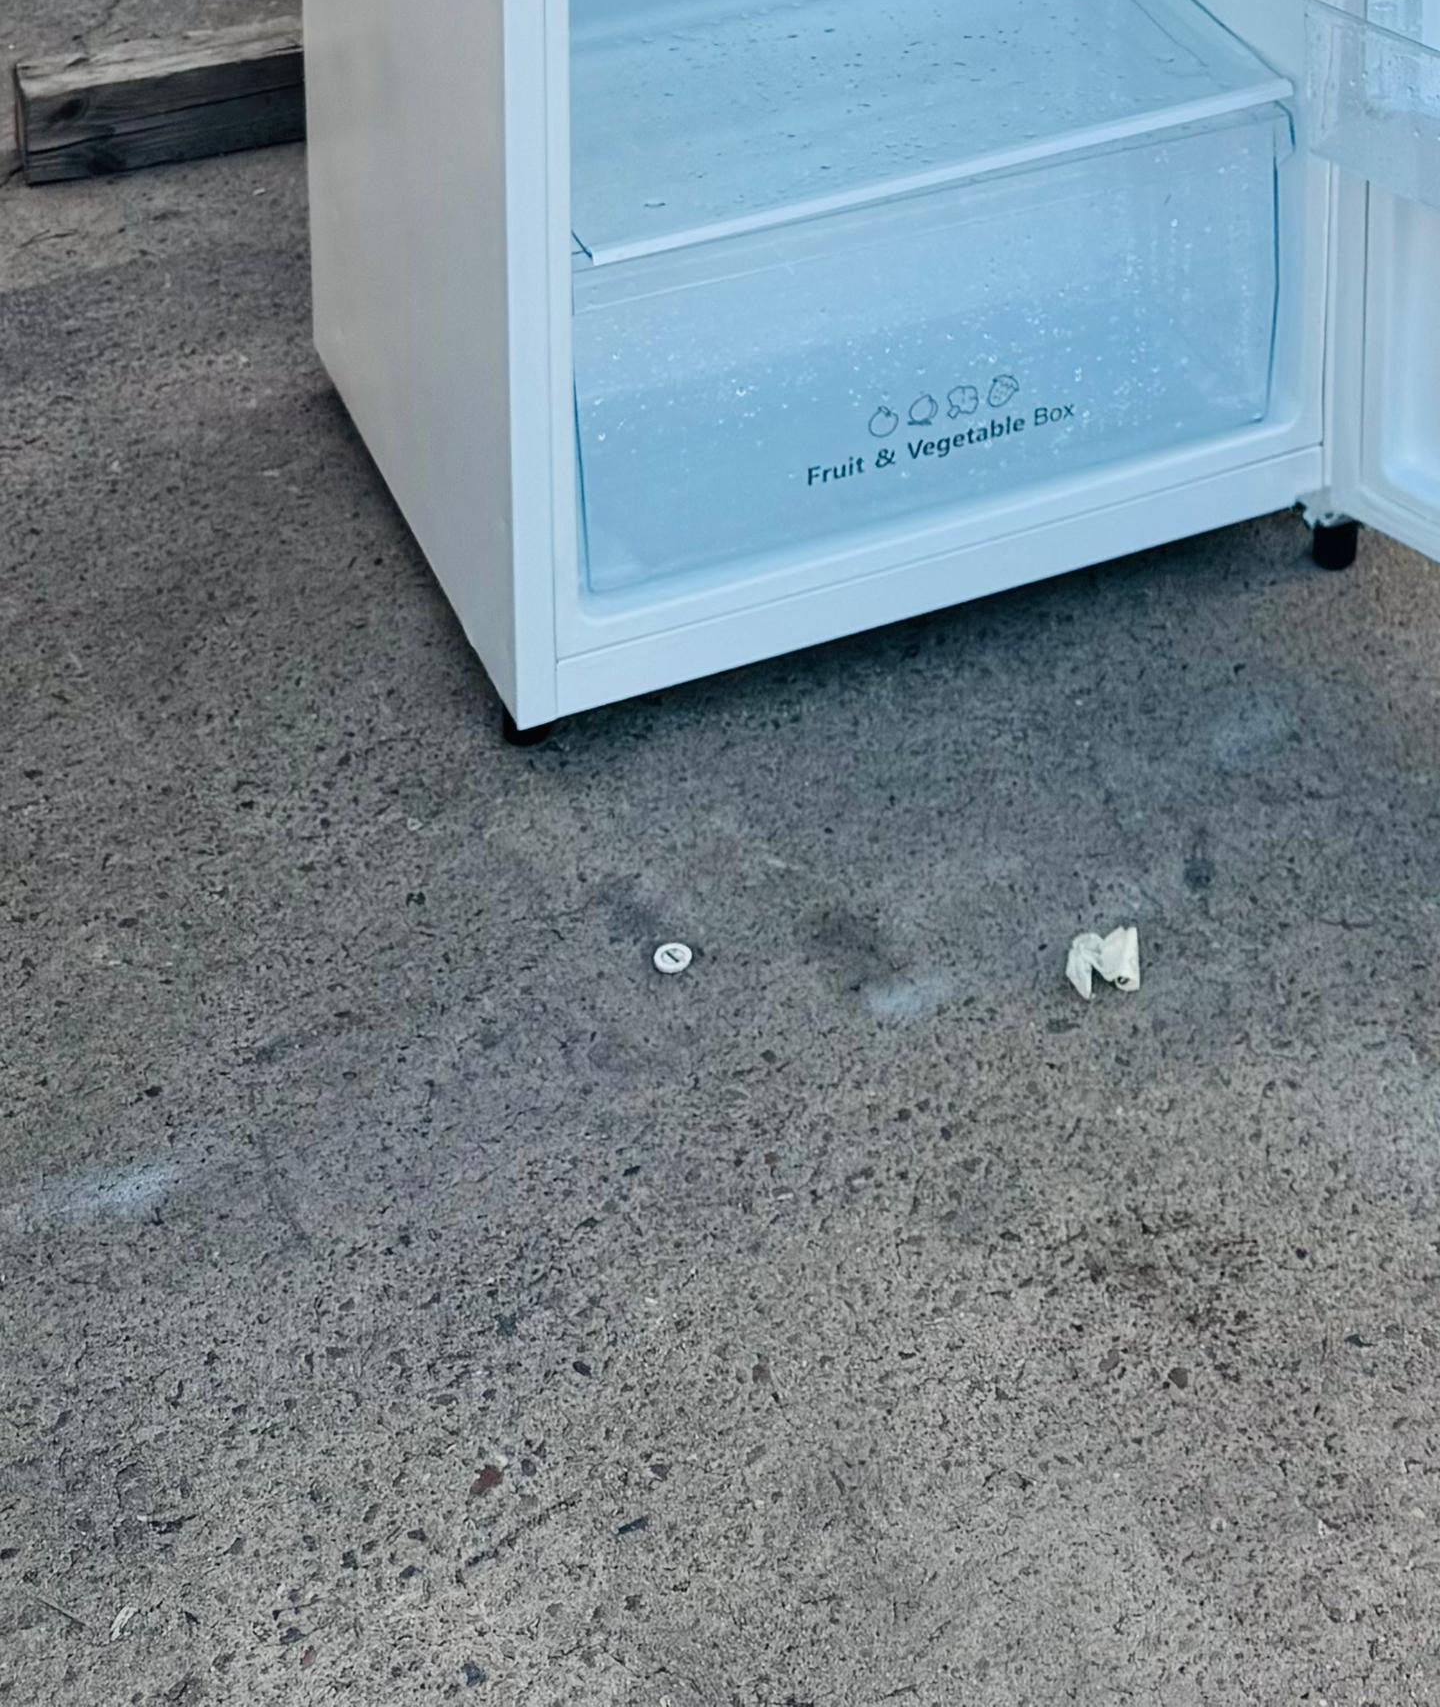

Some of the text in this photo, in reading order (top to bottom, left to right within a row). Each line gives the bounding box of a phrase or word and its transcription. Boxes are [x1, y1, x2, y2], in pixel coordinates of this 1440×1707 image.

[806, 402, 1077, 486] Fruit & Vegetable Box
